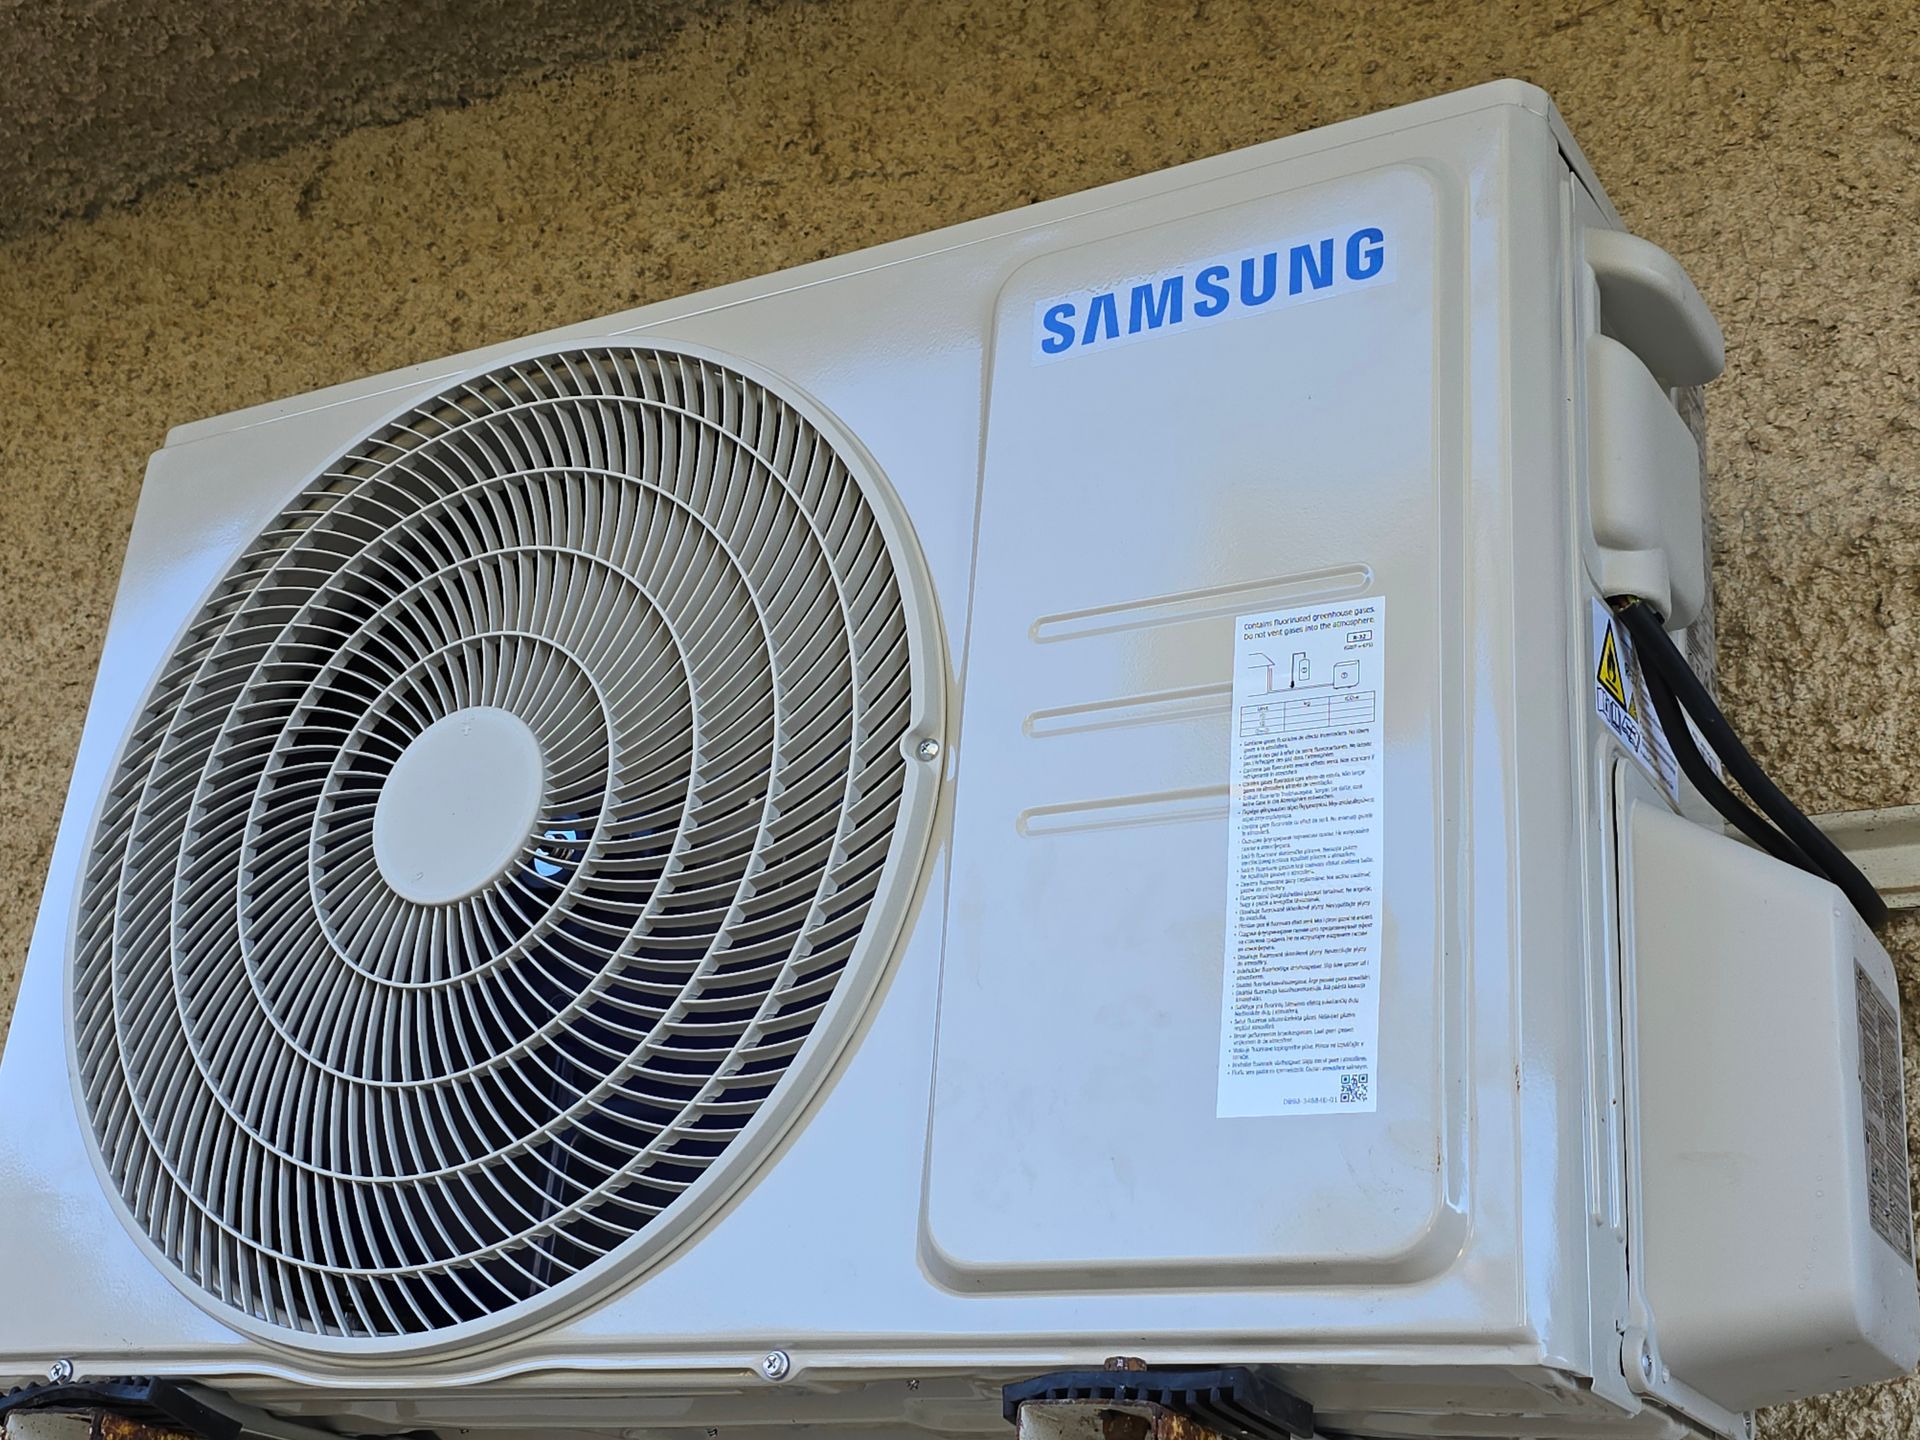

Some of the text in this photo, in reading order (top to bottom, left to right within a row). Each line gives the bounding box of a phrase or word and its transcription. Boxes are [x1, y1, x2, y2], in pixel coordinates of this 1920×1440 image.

[1041, 228, 1384, 354] SAMSUNG
[1273, 615, 1312, 626] fluorinated
[1312, 610, 1353, 622] greenhouse
[1243, 632, 1253, 641] Do
[1254, 631, 1266, 639] not
[1267, 628, 1283, 637] vent
[1284, 625, 1303, 636] gases
[1304, 624, 1318, 632] into
[1319, 621, 1332, 630] the
